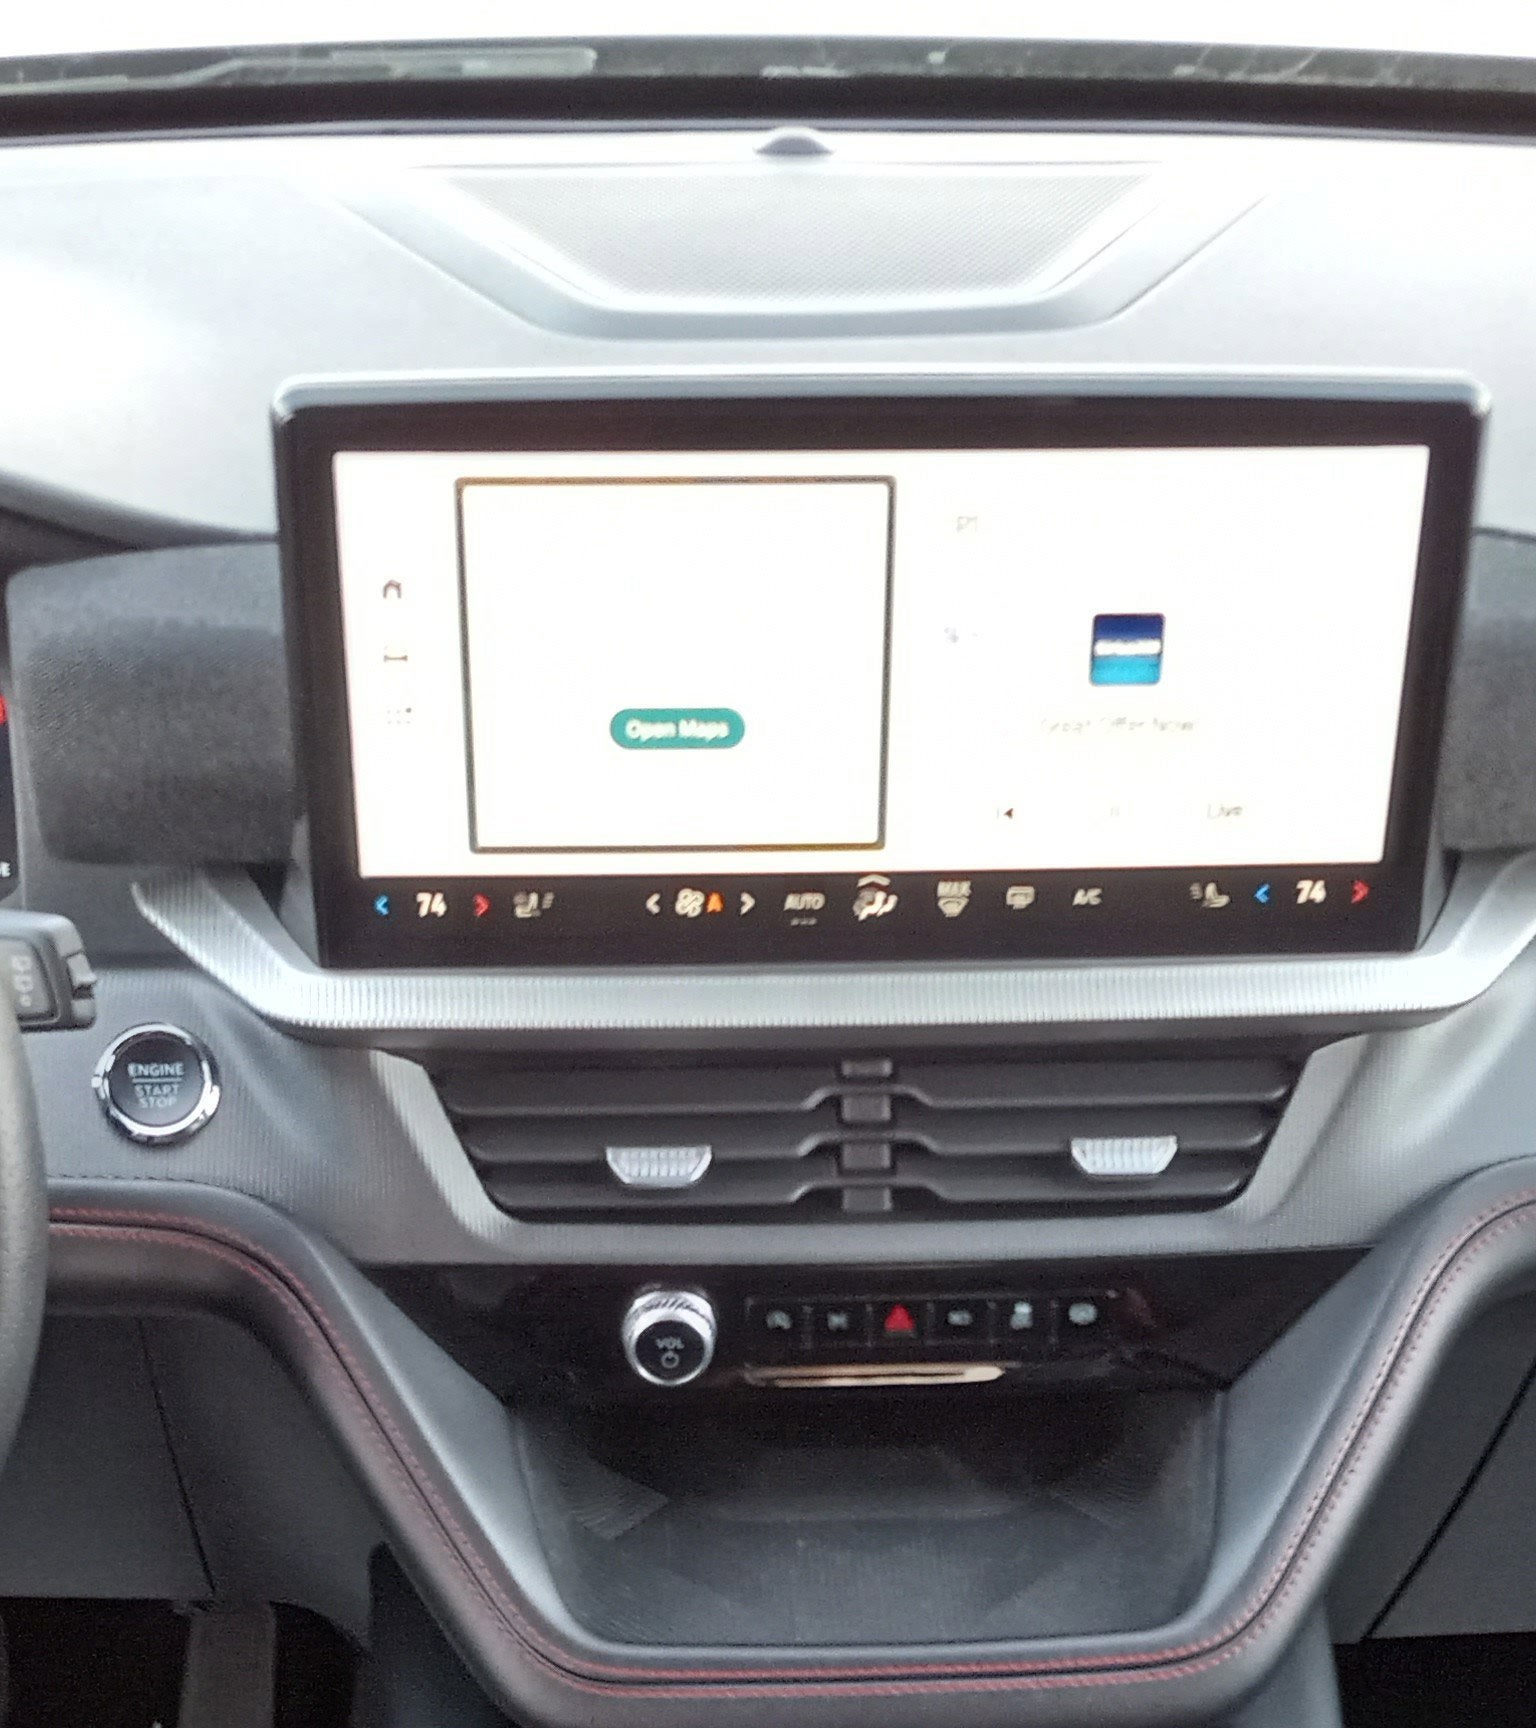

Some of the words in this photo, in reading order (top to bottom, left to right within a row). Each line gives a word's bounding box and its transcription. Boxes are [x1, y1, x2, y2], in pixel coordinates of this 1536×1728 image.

[416, 892, 448, 918] 74
[784, 892, 827, 911] AUTO
[128, 1062, 185, 1077] ENGINE
[135, 1085, 180, 1097] START
[140, 1098, 177, 1108] STOP
